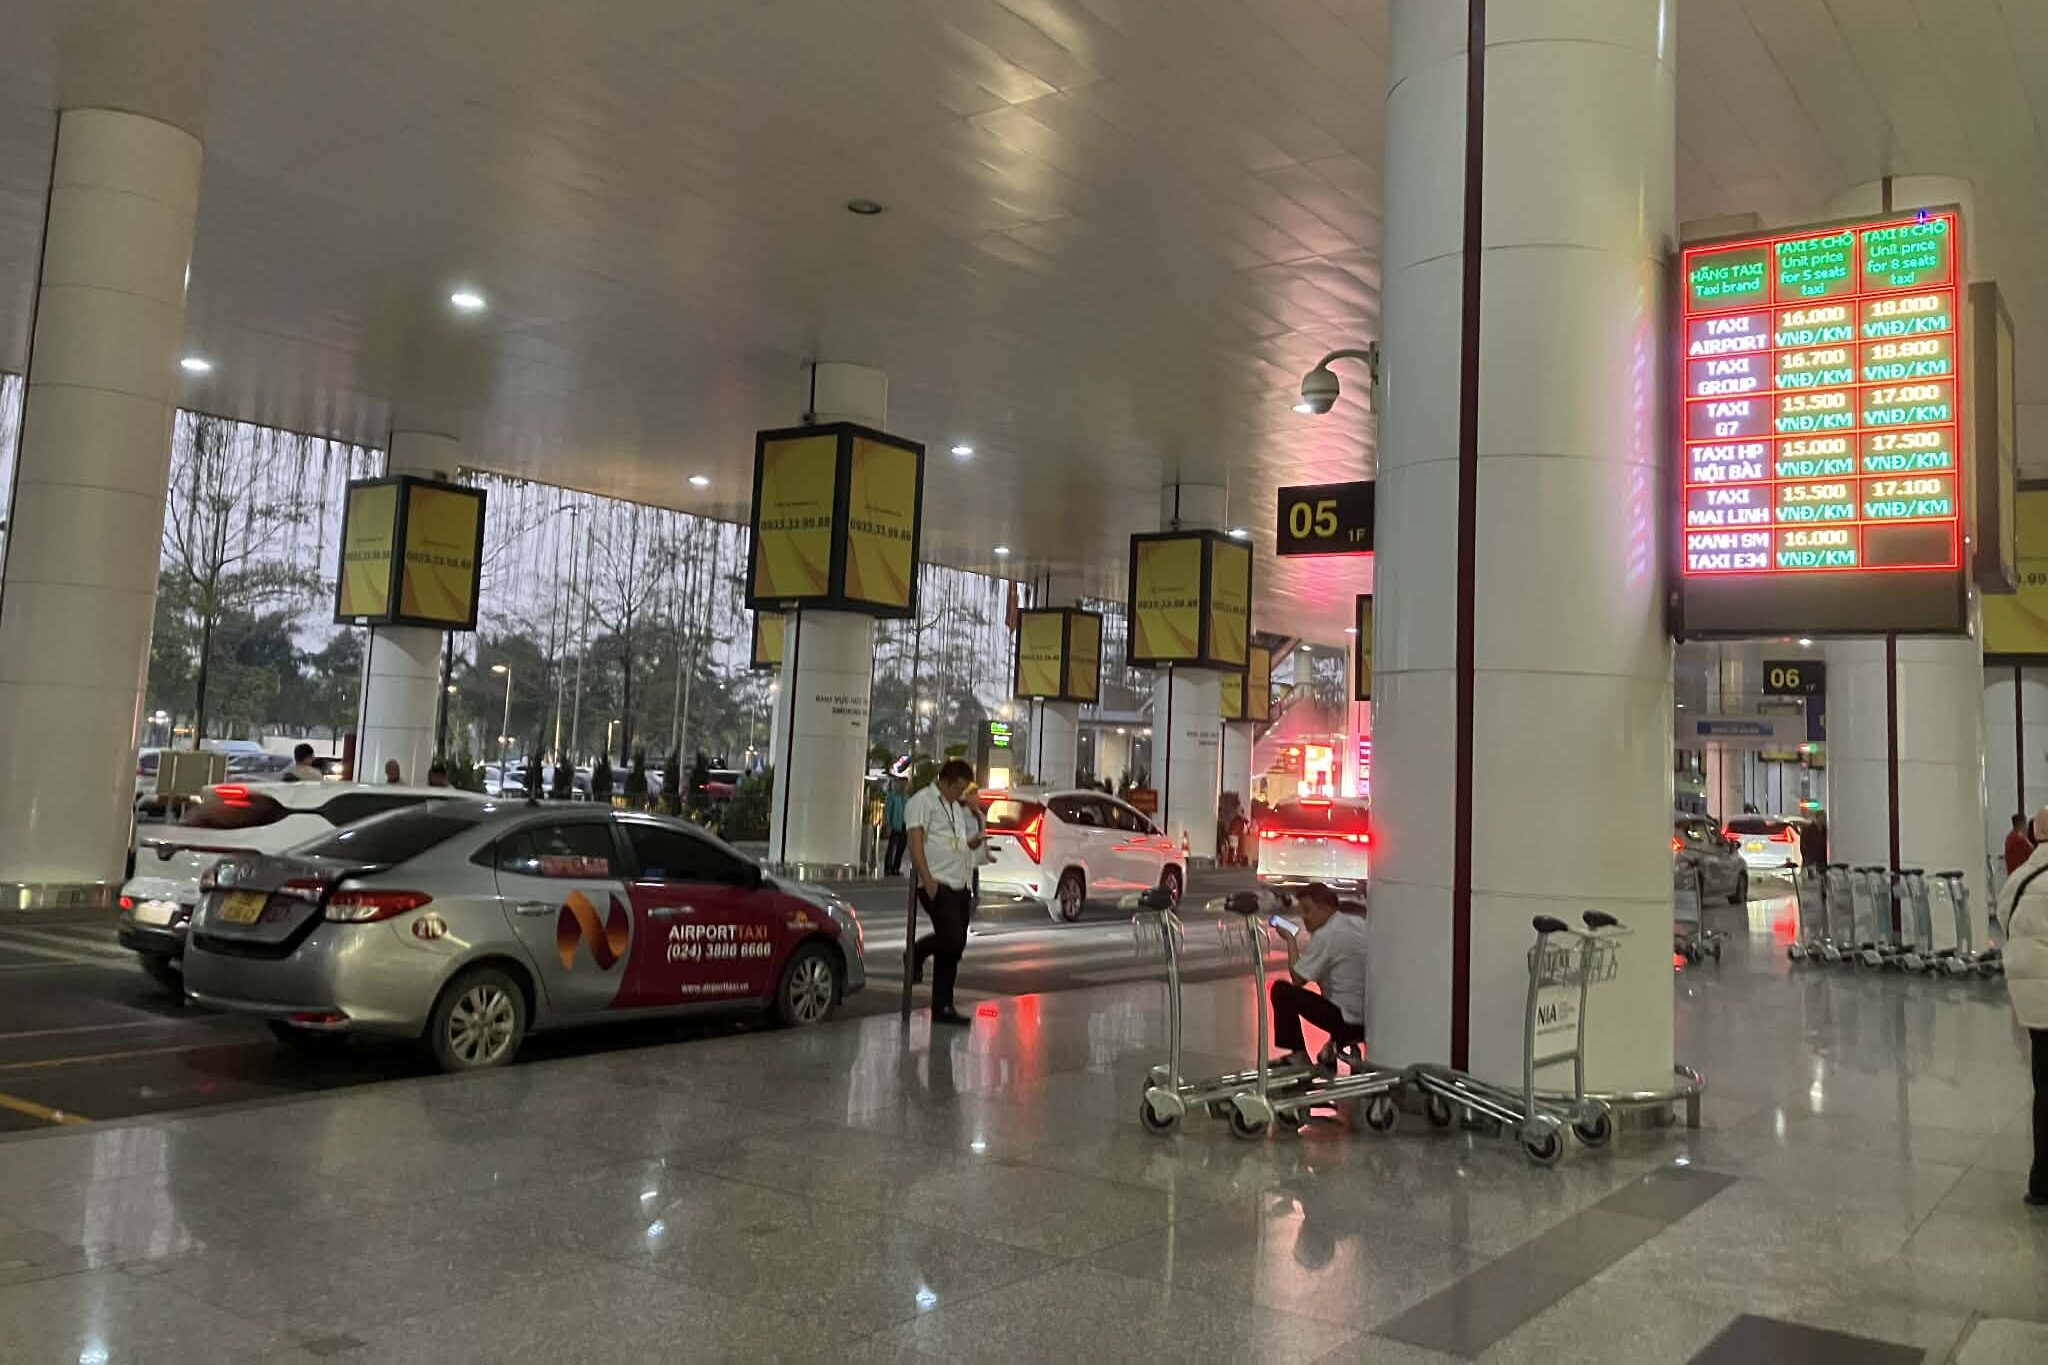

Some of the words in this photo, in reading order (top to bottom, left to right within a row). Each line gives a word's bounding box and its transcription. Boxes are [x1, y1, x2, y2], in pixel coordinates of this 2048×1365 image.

[1862, 229, 1896, 242] TAXI
[1900, 228, 1907, 238] 8
[1775, 240, 1807, 255] TAXI
[1809, 239, 1818, 250] 5
[1871, 245, 1897, 257] Unit
[1902, 240, 1936, 255] price
[1782, 255, 1807, 268] Unit
[1812, 252, 1844, 267] price
[1867, 260, 1888, 273] for
[1891, 259, 1899, 269] 8
[1903, 255, 1936, 269] seats
[1732, 263, 1763, 277] TAXI
[1780, 271, 1800, 284] for
[1803, 270, 1811, 281] 5
[1814, 266, 1847, 280] seats
[1891, 272, 1915, 285] taxi
[1696, 283, 1720, 297] Taxi
[1722, 278, 1760, 293] brand
[1801, 283, 1825, 296] taxi
[1871, 296, 1939, 317] 18.000
[1706, 316, 1750, 335] TAXI
[1782, 306, 1845, 327] 16.000
[1862, 315, 1946, 337] VNĐ/KM
[1689, 334, 1767, 355] AIRPORT
[1775, 326, 1852, 347] VNĐ/KM
[1782, 349, 1845, 369] 16.700
[1871, 339, 1939, 360] 18.800
[1706, 358, 1750, 376] TAXI
[1863, 360, 1947, 380] VNĐ/KM
[1697, 377, 1757, 395] GROUP
[1775, 369, 1853, 389] VNĐ/KM
[1782, 393, 1846, 412] 15.500
[1871, 384, 1940, 405] 17.000
[1706, 401, 1750, 418] TAXI
[1863, 404, 1947, 424] VNĐ/KM
[1715, 421, 1740, 437] G7
[1775, 412, 1853, 432] VNĐ/KM
[1783, 438, 1846, 457] 15.000
[1871, 431, 1940, 451] 17.500
[1692, 445, 1736, 462] TAXI
[1738, 443, 1763, 459] HP
[1863, 451, 1948, 471] VNĐ/KM
[1694, 463, 1726, 483] NỘI
[1729, 460, 1762, 479] BÀI
[1775, 458, 1853, 477] VNĐ/KM
[1707, 489, 1750, 505] TAXI
[1783, 484, 1847, 501] 15.500
[1871, 479, 1941, 497] 17.100
[1687, 510, 1725, 526] MAI
[1728, 508, 1769, 524] LINH
[1776, 504, 1854, 522] VNĐ/KM
[1864, 499, 1949, 518] VNĐ/KM
[1289, 500, 1338, 538] 05
[1348, 528, 1367, 542] 1F
[1687, 533, 1738, 550] XANH
[1741, 533, 1769, 548] SM
[1784, 530, 1848, 547] 16.000
[1688, 554, 1730, 569] TAXI
[1734, 553, 1767, 568] E34
[1776, 550, 1856, 568] VNĐ/KM
[1770, 668, 1800, 688] 06
[666, 942, 702, 963] (024)
[1537, 1004, 1557, 1026] NIA
